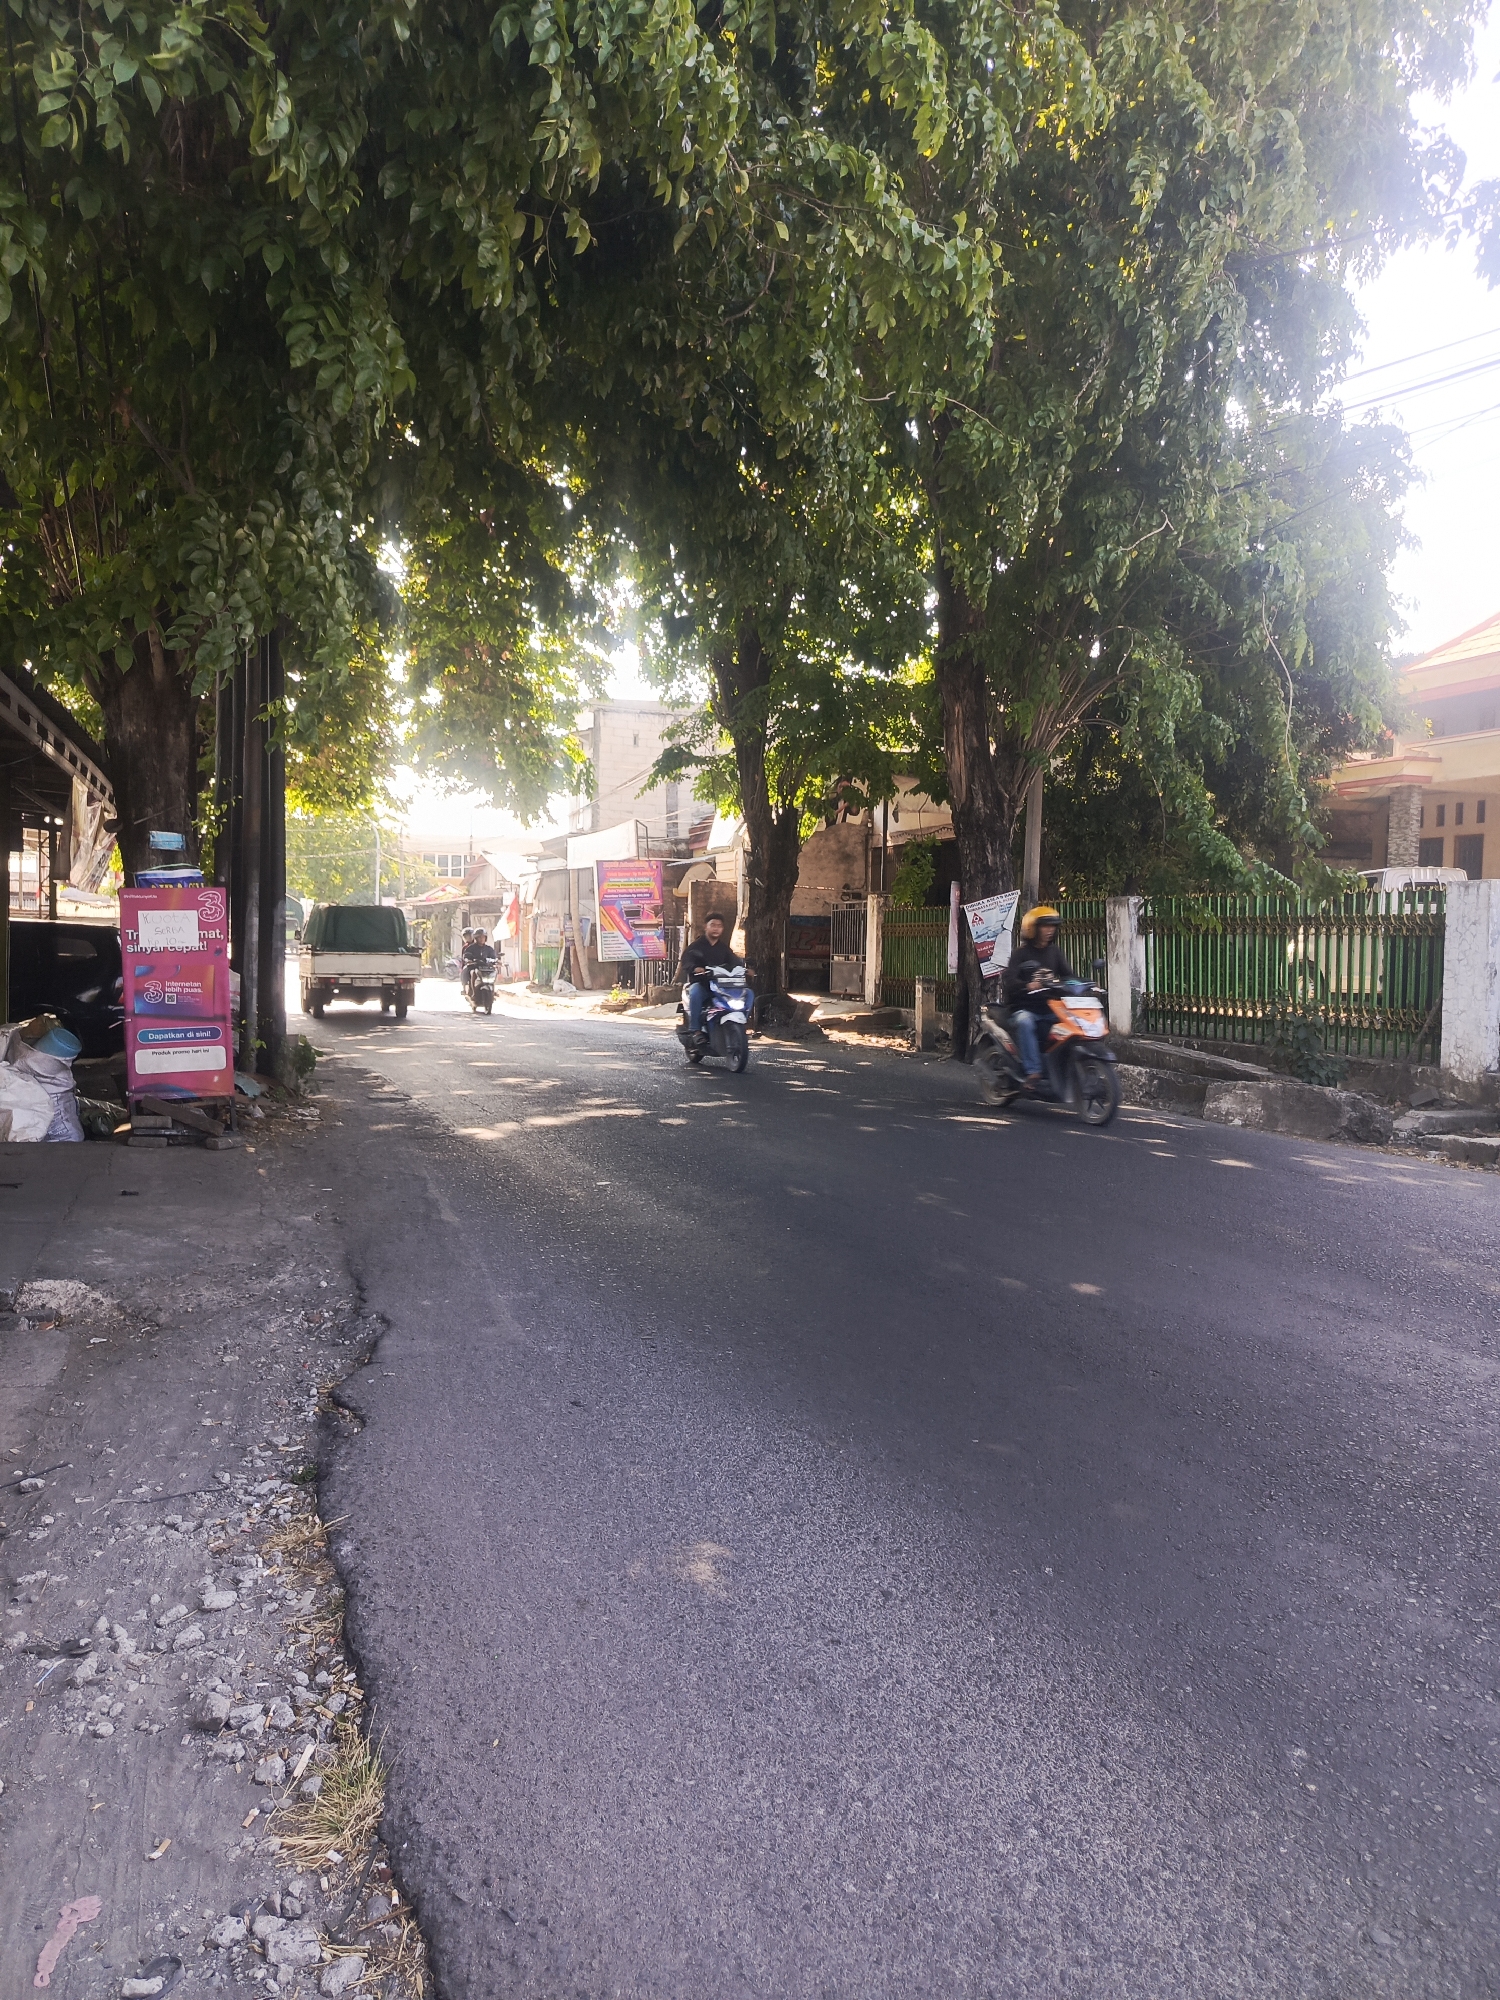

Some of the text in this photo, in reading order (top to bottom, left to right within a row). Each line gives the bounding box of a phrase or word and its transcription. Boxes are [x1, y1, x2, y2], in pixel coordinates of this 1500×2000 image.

[197, 890, 225, 923] 3
[143, 980, 164, 1004] 3
[148, 1032, 185, 1041] Dapatkan
[195, 1030, 211, 1038] sini!
